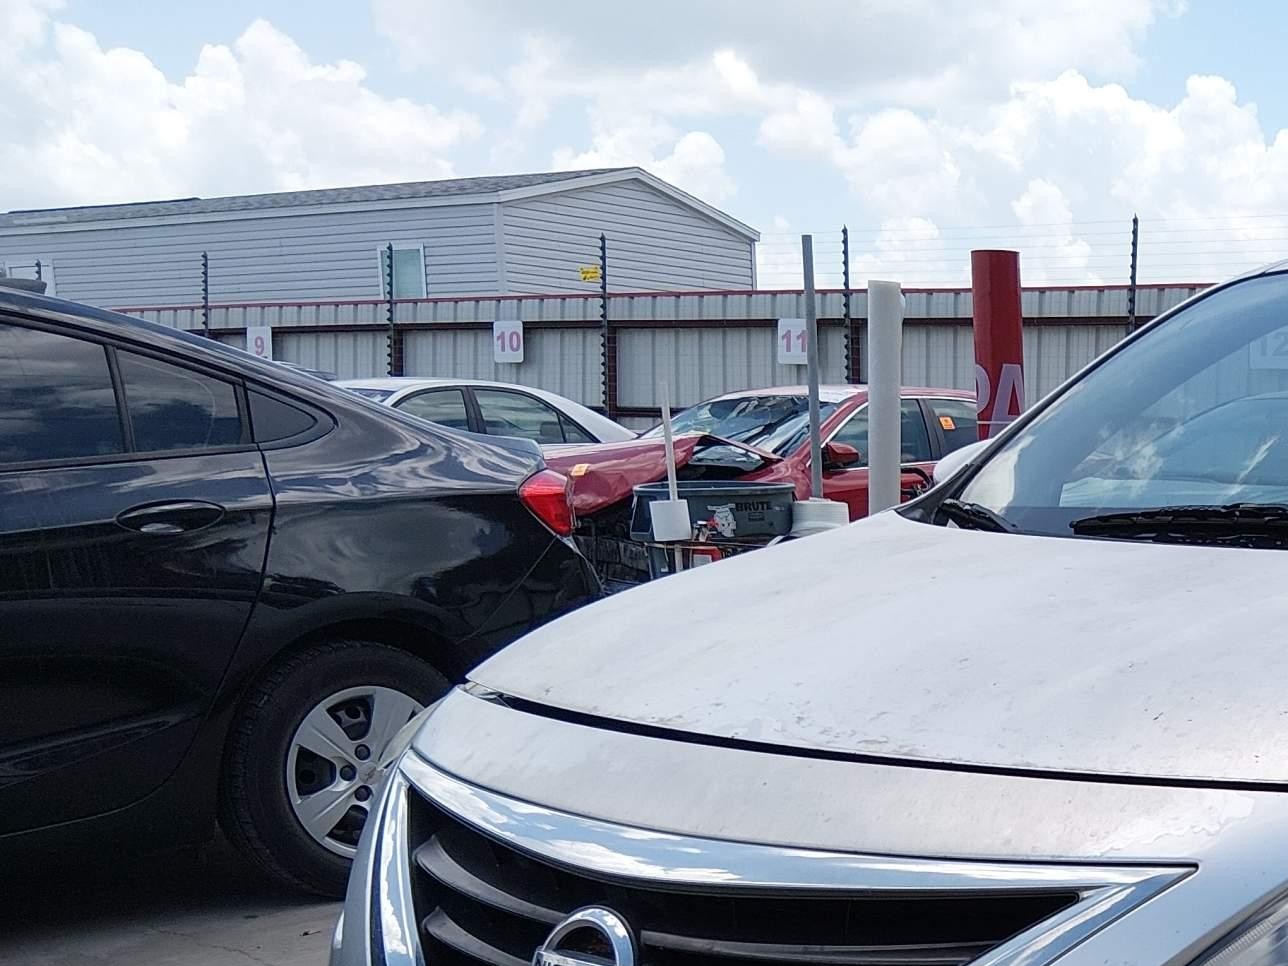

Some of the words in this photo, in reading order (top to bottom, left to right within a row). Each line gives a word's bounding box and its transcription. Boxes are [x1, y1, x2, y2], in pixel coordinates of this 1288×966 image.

[254, 335, 265, 357] 9
[496, 330, 521, 353] 10
[781, 329, 808, 353] 11
[735, 501, 773, 513] BRUTE
